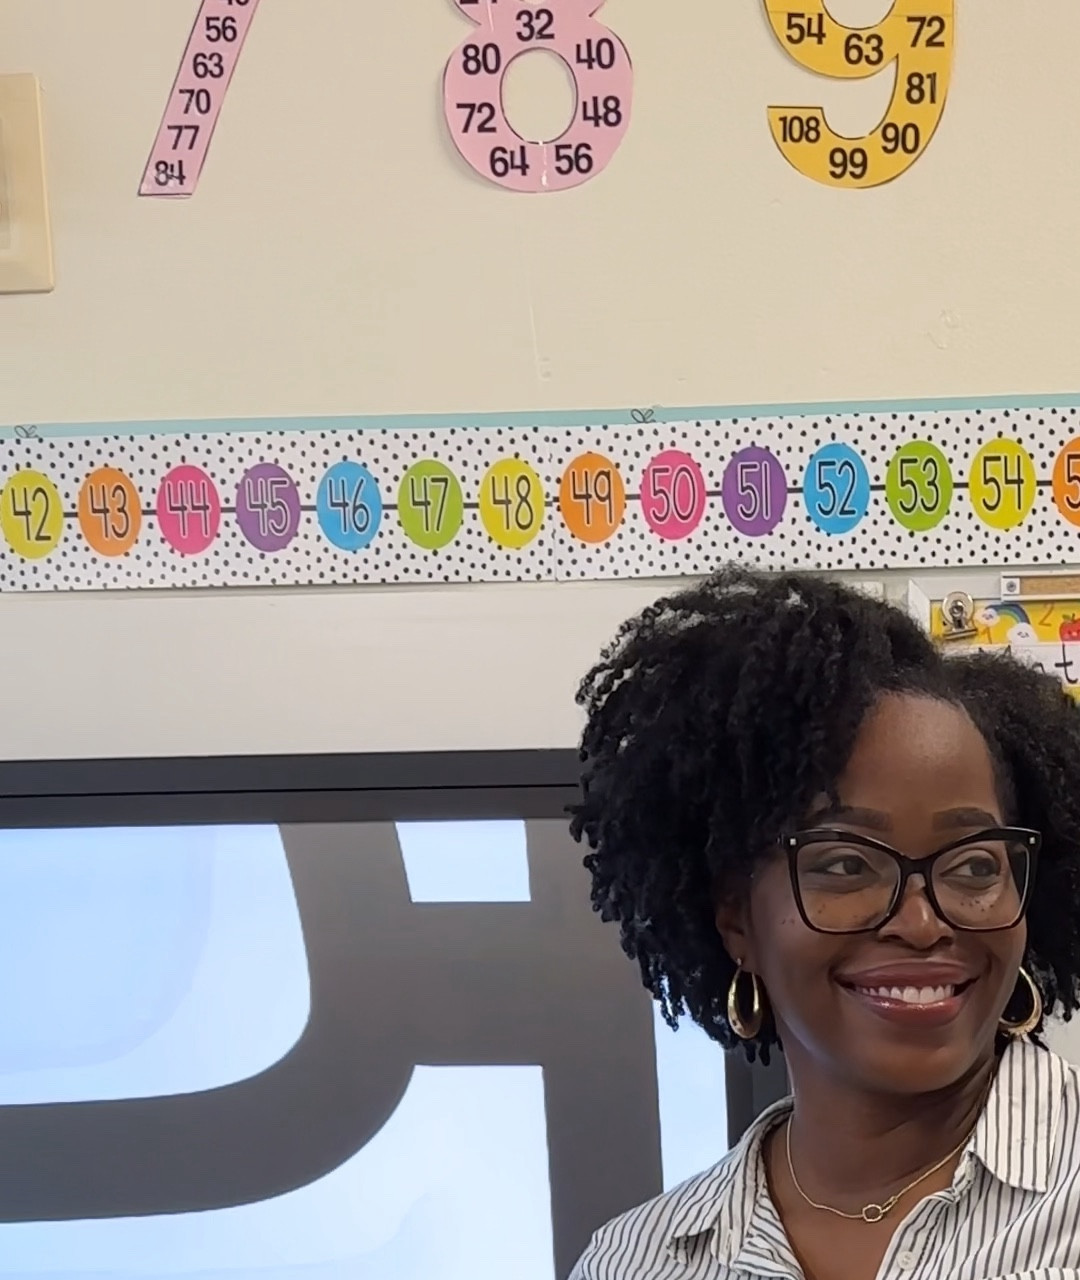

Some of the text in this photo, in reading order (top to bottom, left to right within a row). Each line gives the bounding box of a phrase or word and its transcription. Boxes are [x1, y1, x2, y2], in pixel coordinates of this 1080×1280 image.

[204, 17, 237, 43] 56
[515, 10, 555, 40] 32
[461, 44, 500, 74] 80
[179, 90, 211, 115] 70
[456, 103, 496, 133] 72
[778, 116, 820, 144] 108
[881, 122, 921, 154] 90
[154, 161, 185, 186] 84
[554, 144, 593, 174] 56
[828, 148, 868, 179] 99
[650, 464, 695, 522] 50
[899, 458, 939, 515] 53
[11, 487, 51, 542] 42
[166, 481, 210, 535] 44
[409, 475, 449, 532] 47
